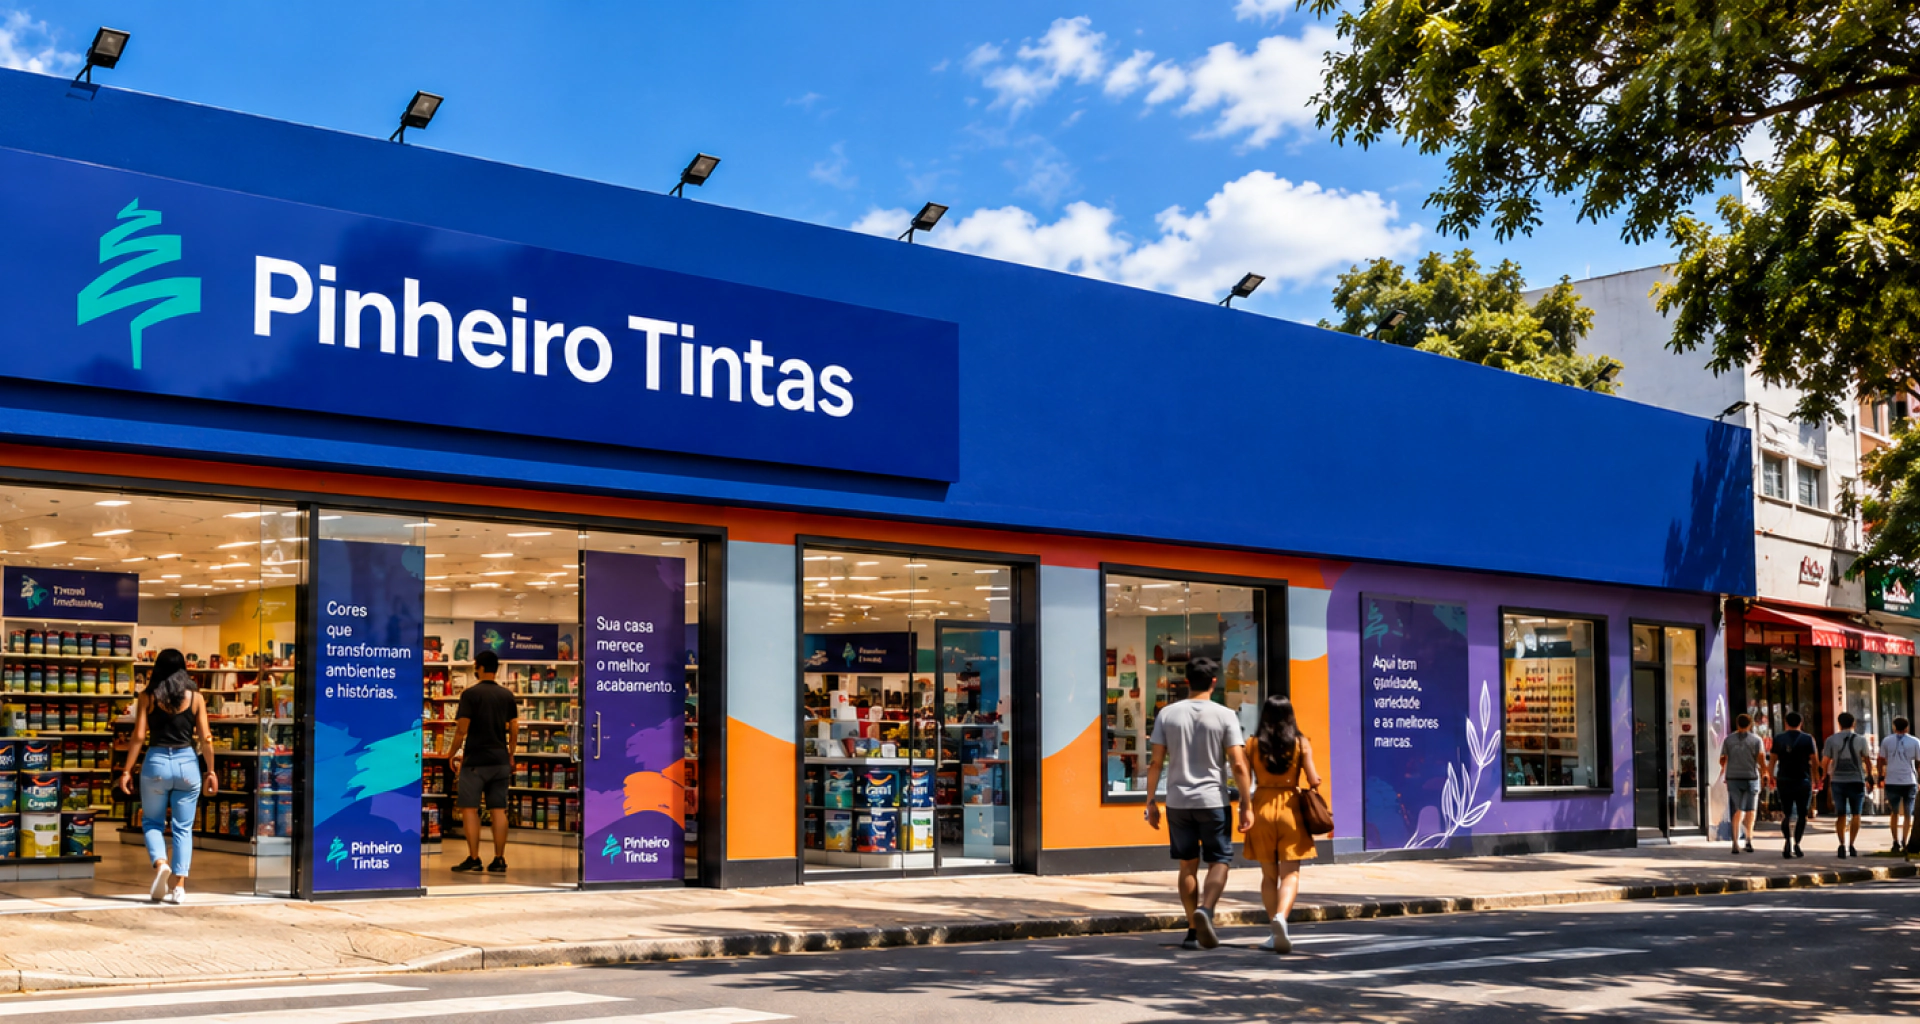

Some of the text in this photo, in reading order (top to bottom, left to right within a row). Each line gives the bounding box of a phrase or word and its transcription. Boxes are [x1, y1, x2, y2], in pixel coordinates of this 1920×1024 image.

[253, 255, 854, 418] Pinheiro Tintas
[327, 600, 368, 617] Cores
[596, 615, 654, 633] Sua casa
[326, 625, 352, 639] que
[326, 642, 411, 659] transformam
[596, 640, 644, 653] merece
[325, 663, 396, 679] ambientes
[596, 658, 651, 673] o melhor
[1372, 654, 1417, 673] Aqui tem
[325, 683, 397, 699] e histórias.
[596, 678, 676, 693] acabamento.
[1374, 695, 1421, 709] variedade
[1374, 717, 1381, 728] e
[1382, 717, 1394, 729] as
[1374, 736, 1413, 748] marcas.
[351, 840, 403, 855] Pinheiro
[623, 836, 670, 849] Pinheiro
[351, 857, 390, 869] Tintas
[623, 850, 659, 863] Tintas
